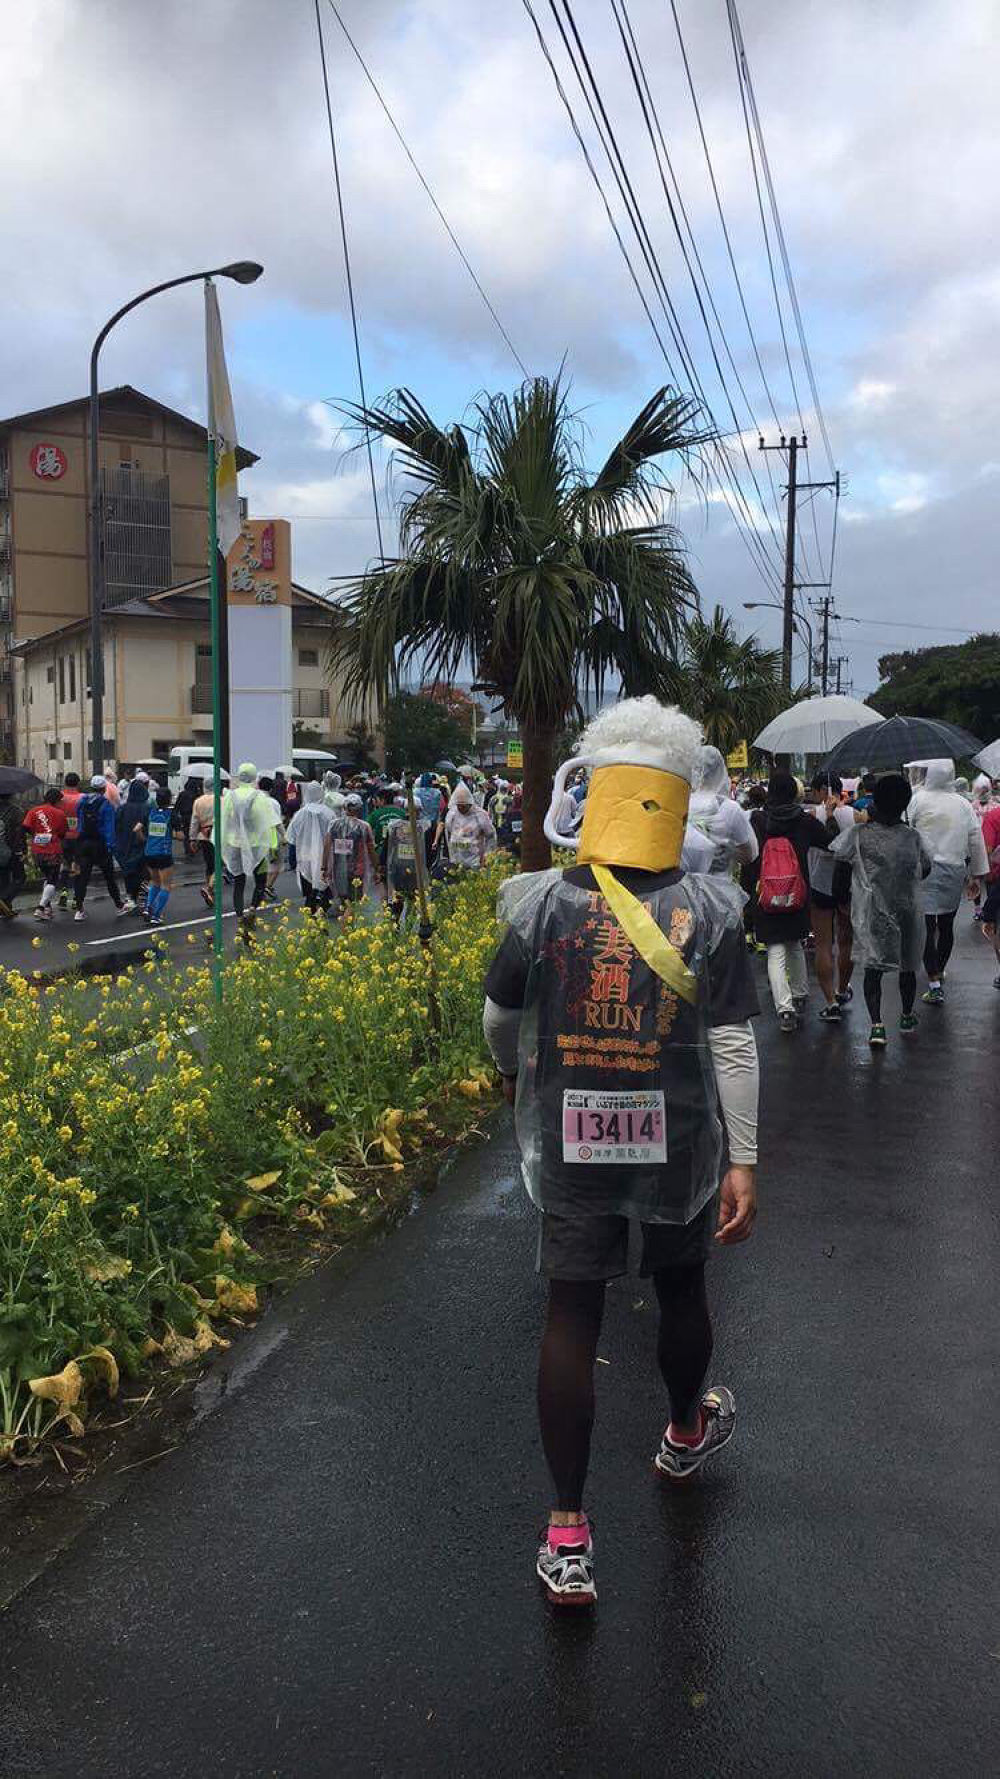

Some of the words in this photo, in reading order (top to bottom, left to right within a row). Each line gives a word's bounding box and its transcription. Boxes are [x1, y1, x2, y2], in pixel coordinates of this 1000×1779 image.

[36, 447, 63, 477] 湯
[591, 919, 633, 1003] 美酒
[584, 1001, 644, 1032] RUN
[577, 1112, 654, 1142] 13414
